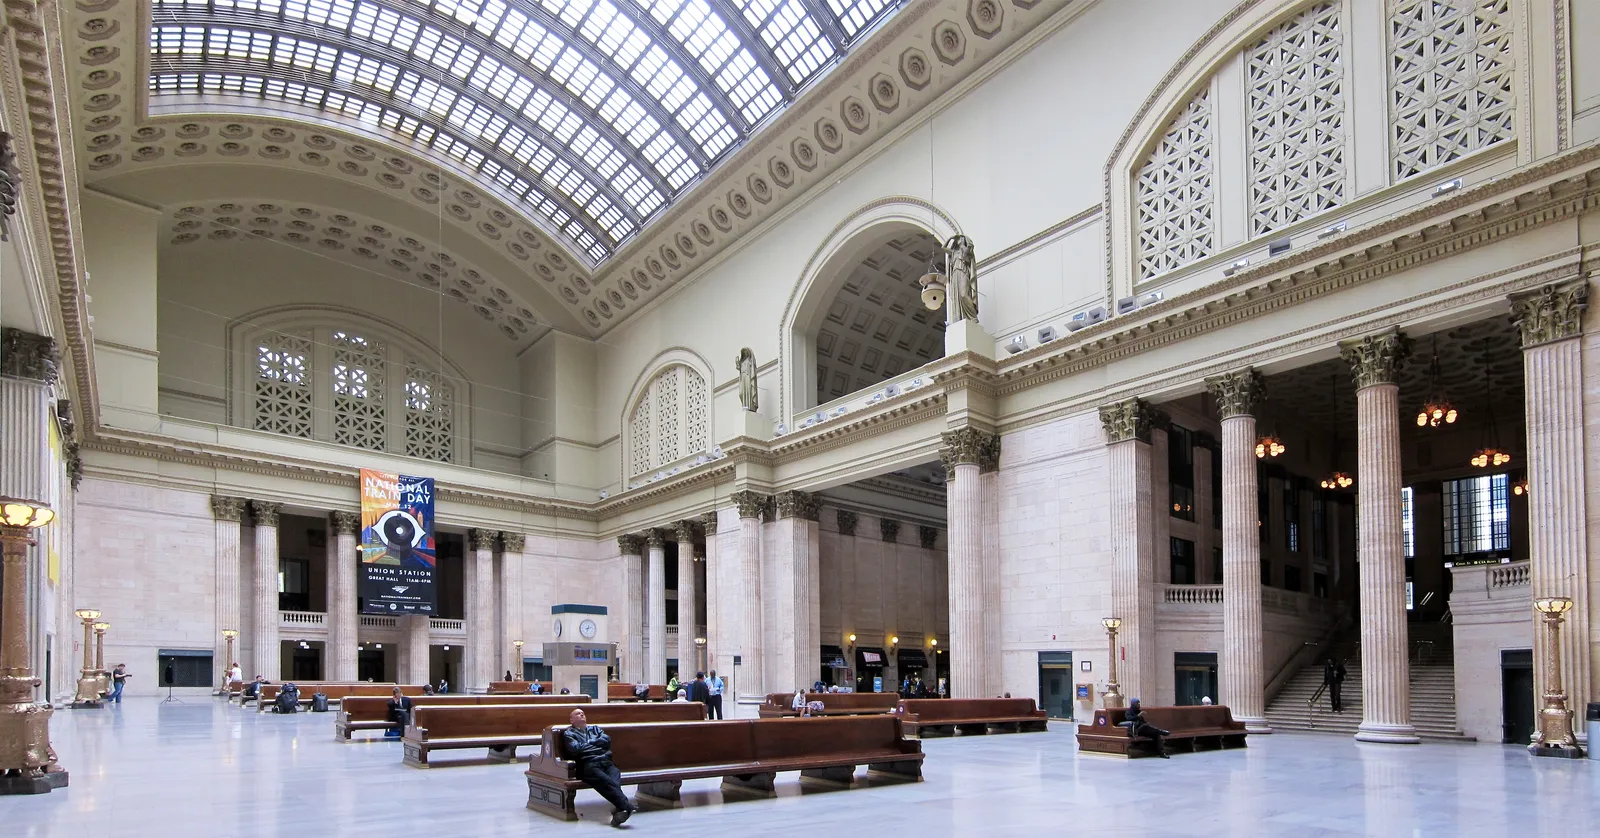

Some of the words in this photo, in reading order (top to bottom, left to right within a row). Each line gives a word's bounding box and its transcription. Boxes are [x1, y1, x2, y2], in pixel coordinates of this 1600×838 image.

[365, 476, 430, 495] NATIONAL
[364, 487, 401, 501] TRAIN
[407, 492, 431, 505] DAY
[368, 567, 395, 575] UNION
[399, 569, 431, 577] STATION
